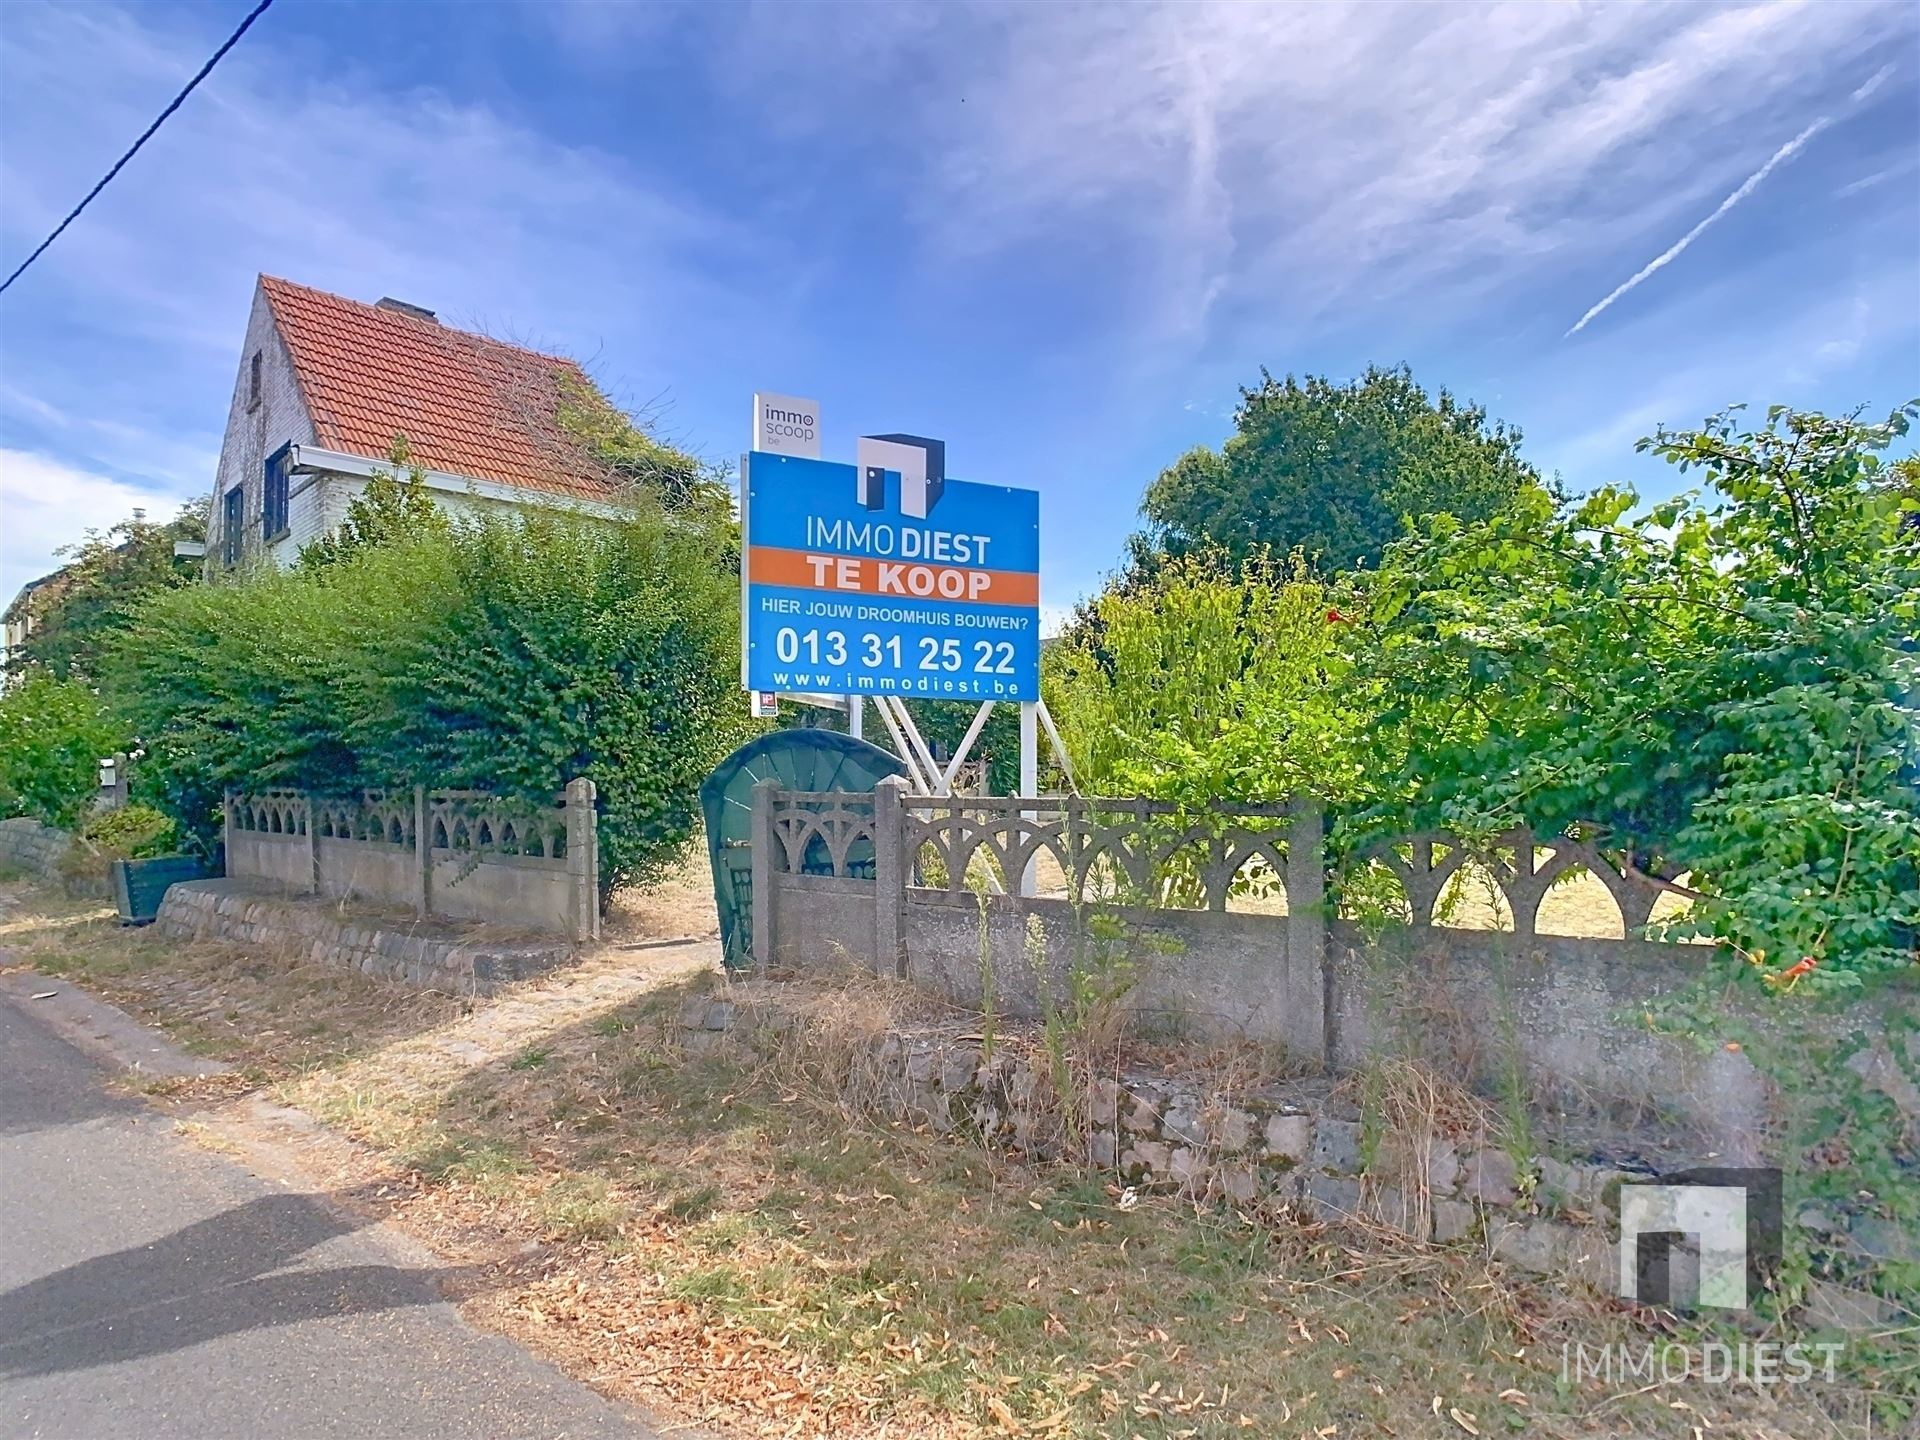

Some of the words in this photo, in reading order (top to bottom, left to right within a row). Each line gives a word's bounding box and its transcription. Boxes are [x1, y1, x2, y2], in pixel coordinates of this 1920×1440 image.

[766, 404, 814, 426] immo
[766, 423, 814, 442] scoop
[807, 516, 894, 554] IMMO
[901, 528, 991, 565] DIEST
[806, 555, 860, 590] TE
[878, 562, 991, 600] KOOP
[762, 597, 801, 614] HIER
[805, 603, 853, 619] JOUW
[857, 606, 950, 626] DROOMHUIS
[955, 613, 1029, 630] BOUWEN?
[776, 627, 848, 667] 013
[862, 633, 902, 669] 31
[919, 637, 962, 674] 25
[973, 641, 1016, 674] 22
[773, 673, 1018, 695] www.immodiest.be
